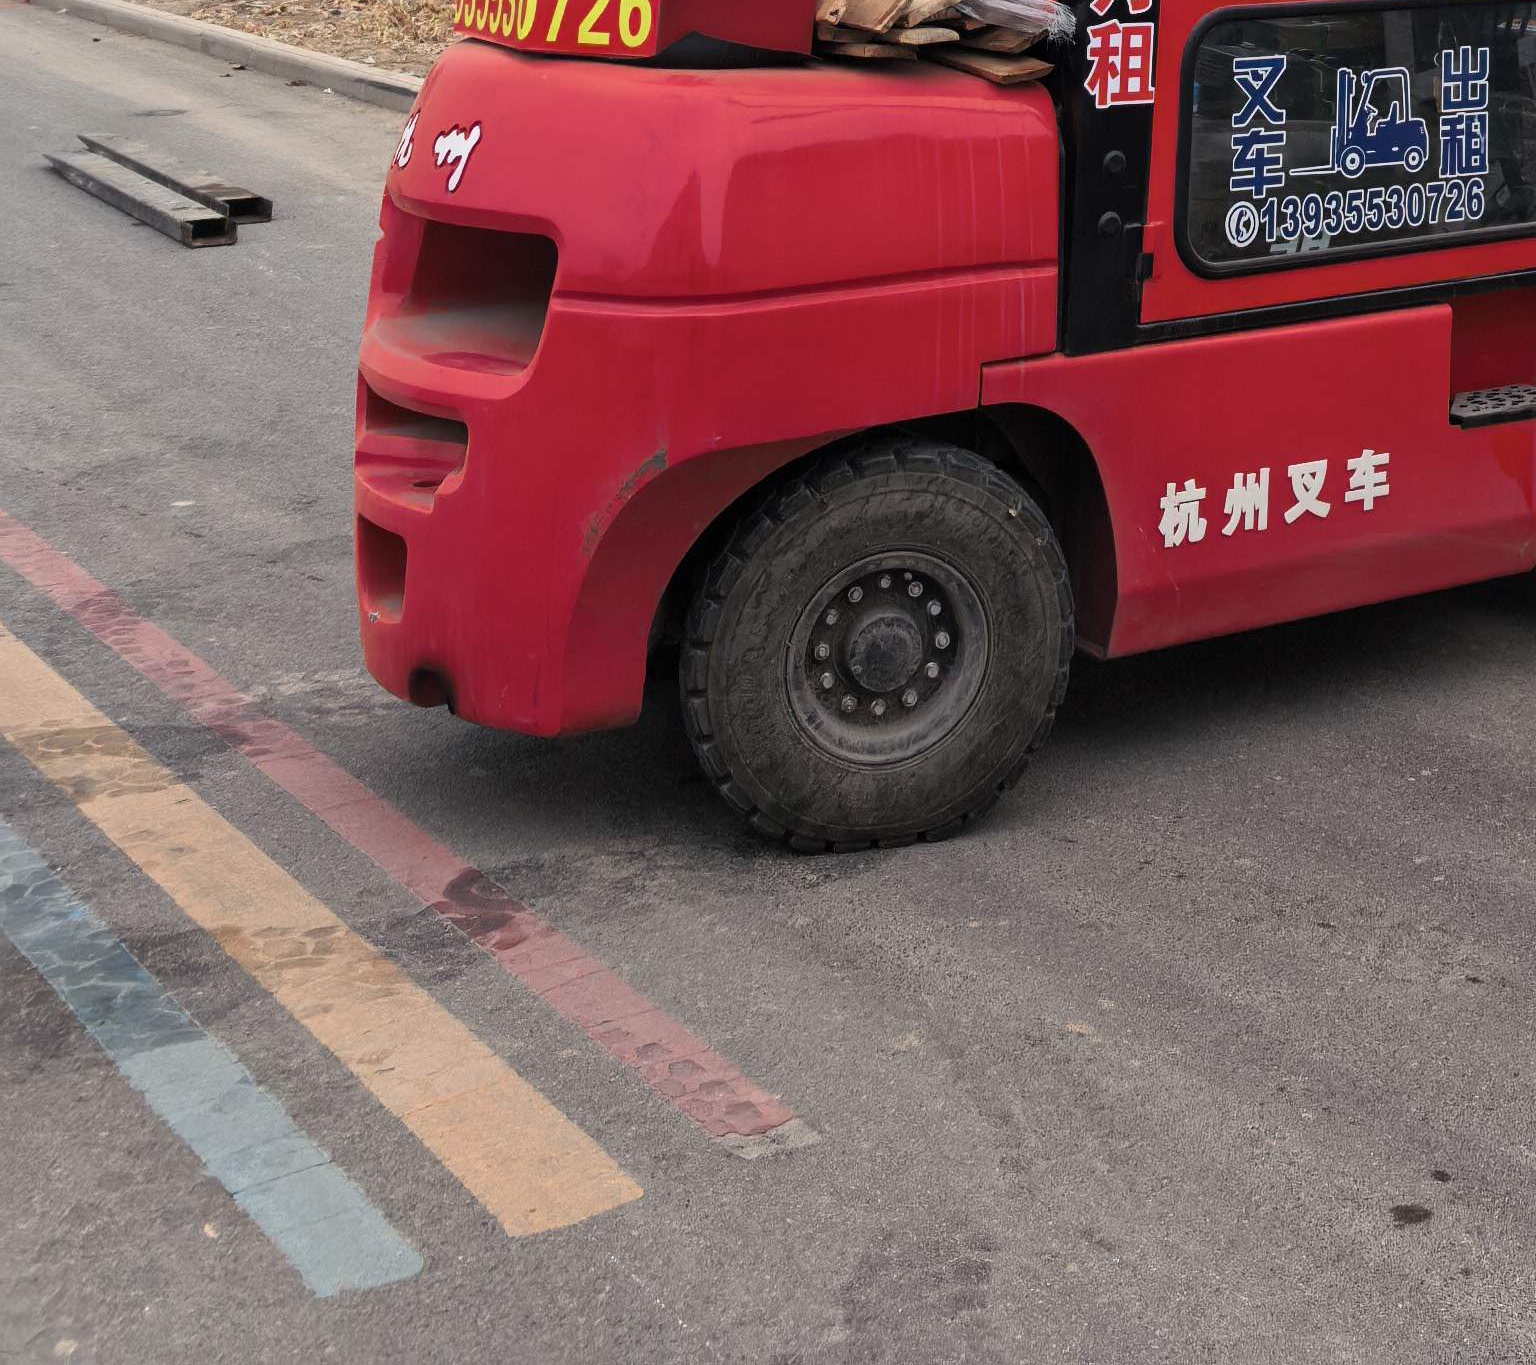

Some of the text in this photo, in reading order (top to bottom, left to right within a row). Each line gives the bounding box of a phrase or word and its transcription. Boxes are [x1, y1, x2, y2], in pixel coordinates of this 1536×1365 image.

[1230, 54, 1287, 199] 叉车
[1439, 45, 1490, 178] 出租
[1259, 178, 1486, 243] 13935530726
[1158, 449, 1390, 548] 杭州叉车
